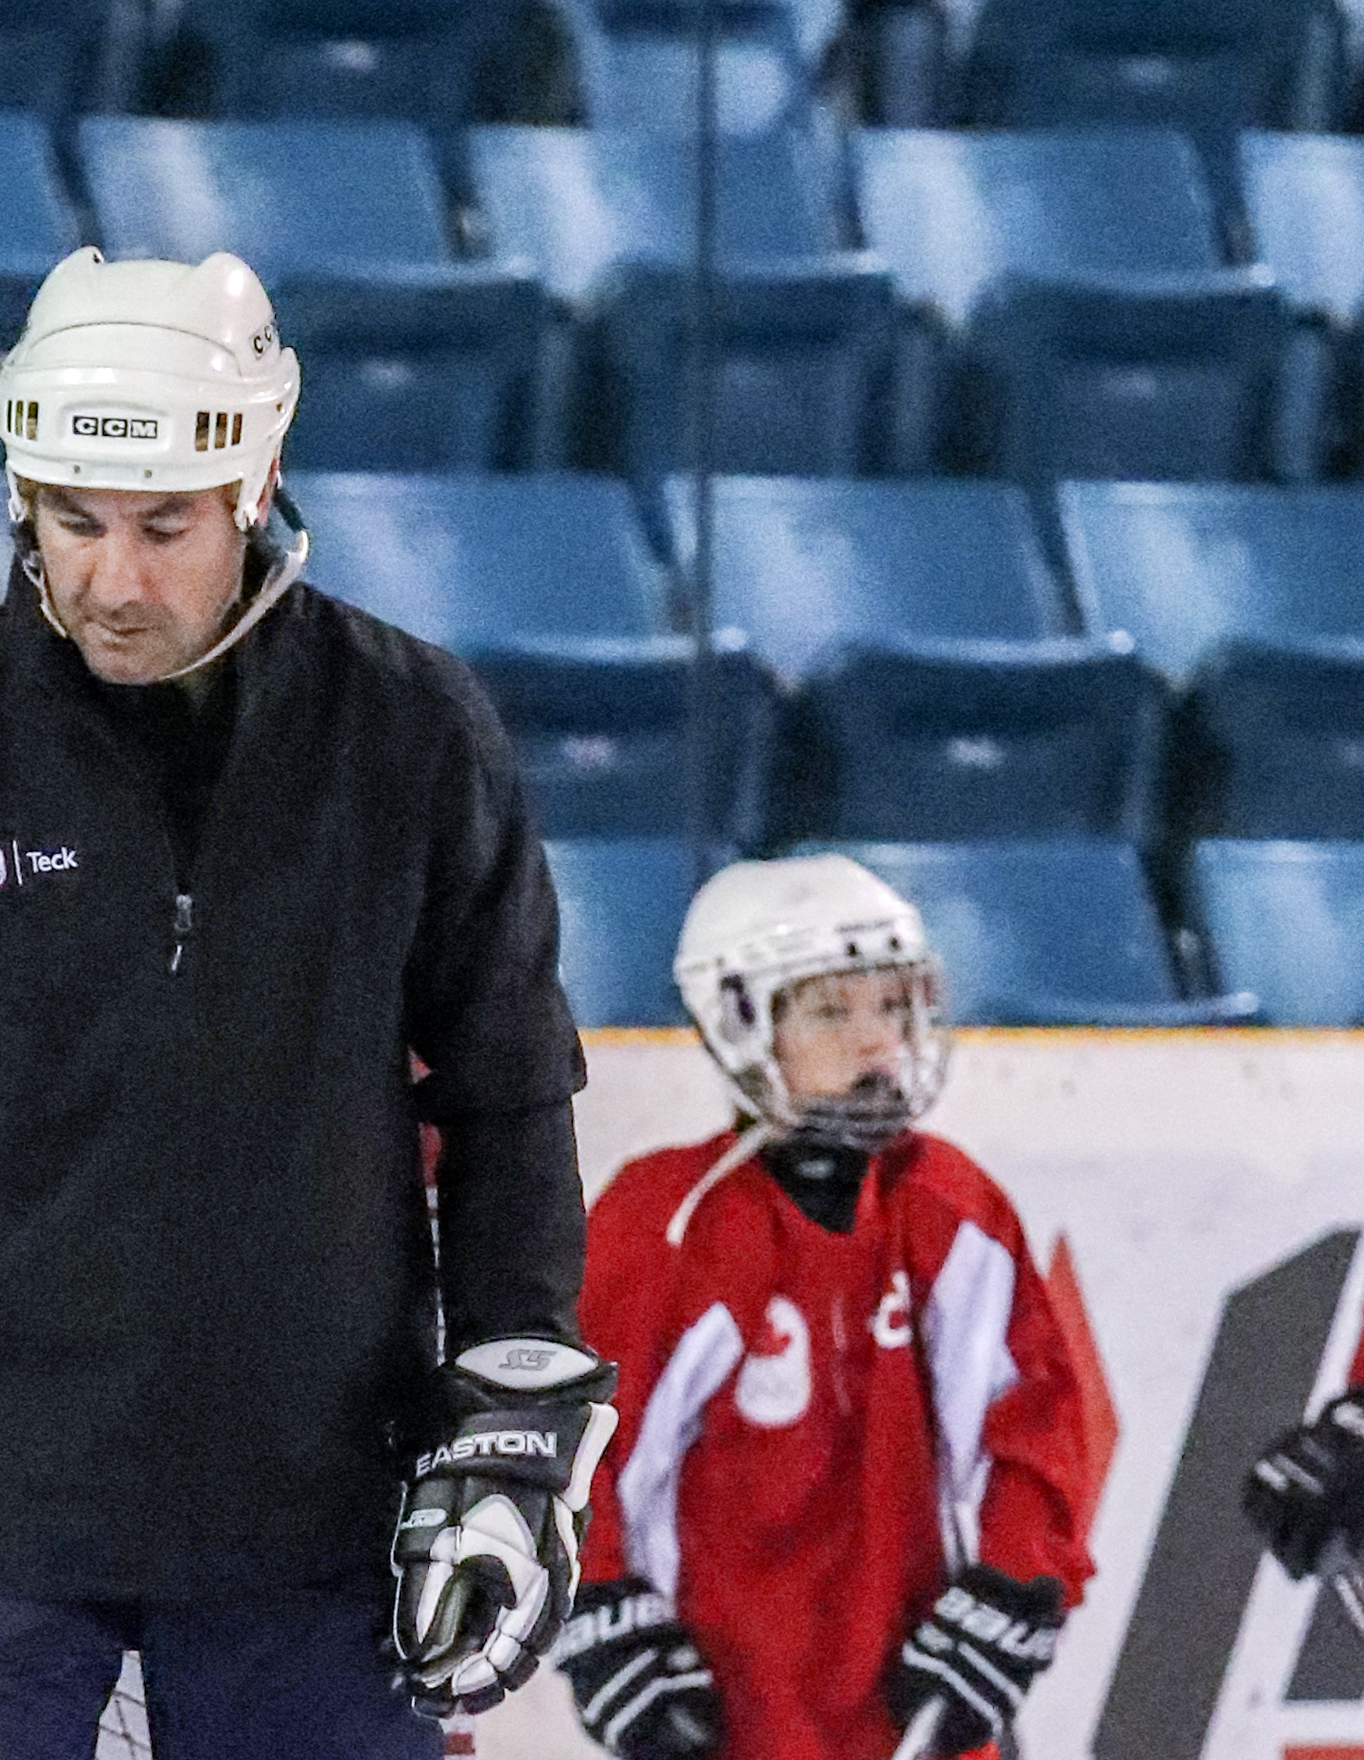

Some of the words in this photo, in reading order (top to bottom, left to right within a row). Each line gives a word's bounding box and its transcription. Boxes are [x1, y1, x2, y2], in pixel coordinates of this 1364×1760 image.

[253, 323, 277, 354] CC
[72, 415, 158, 438] CCM
[26, 846, 79, 873] Teck
[415, 1430, 558, 1478] EASTON
